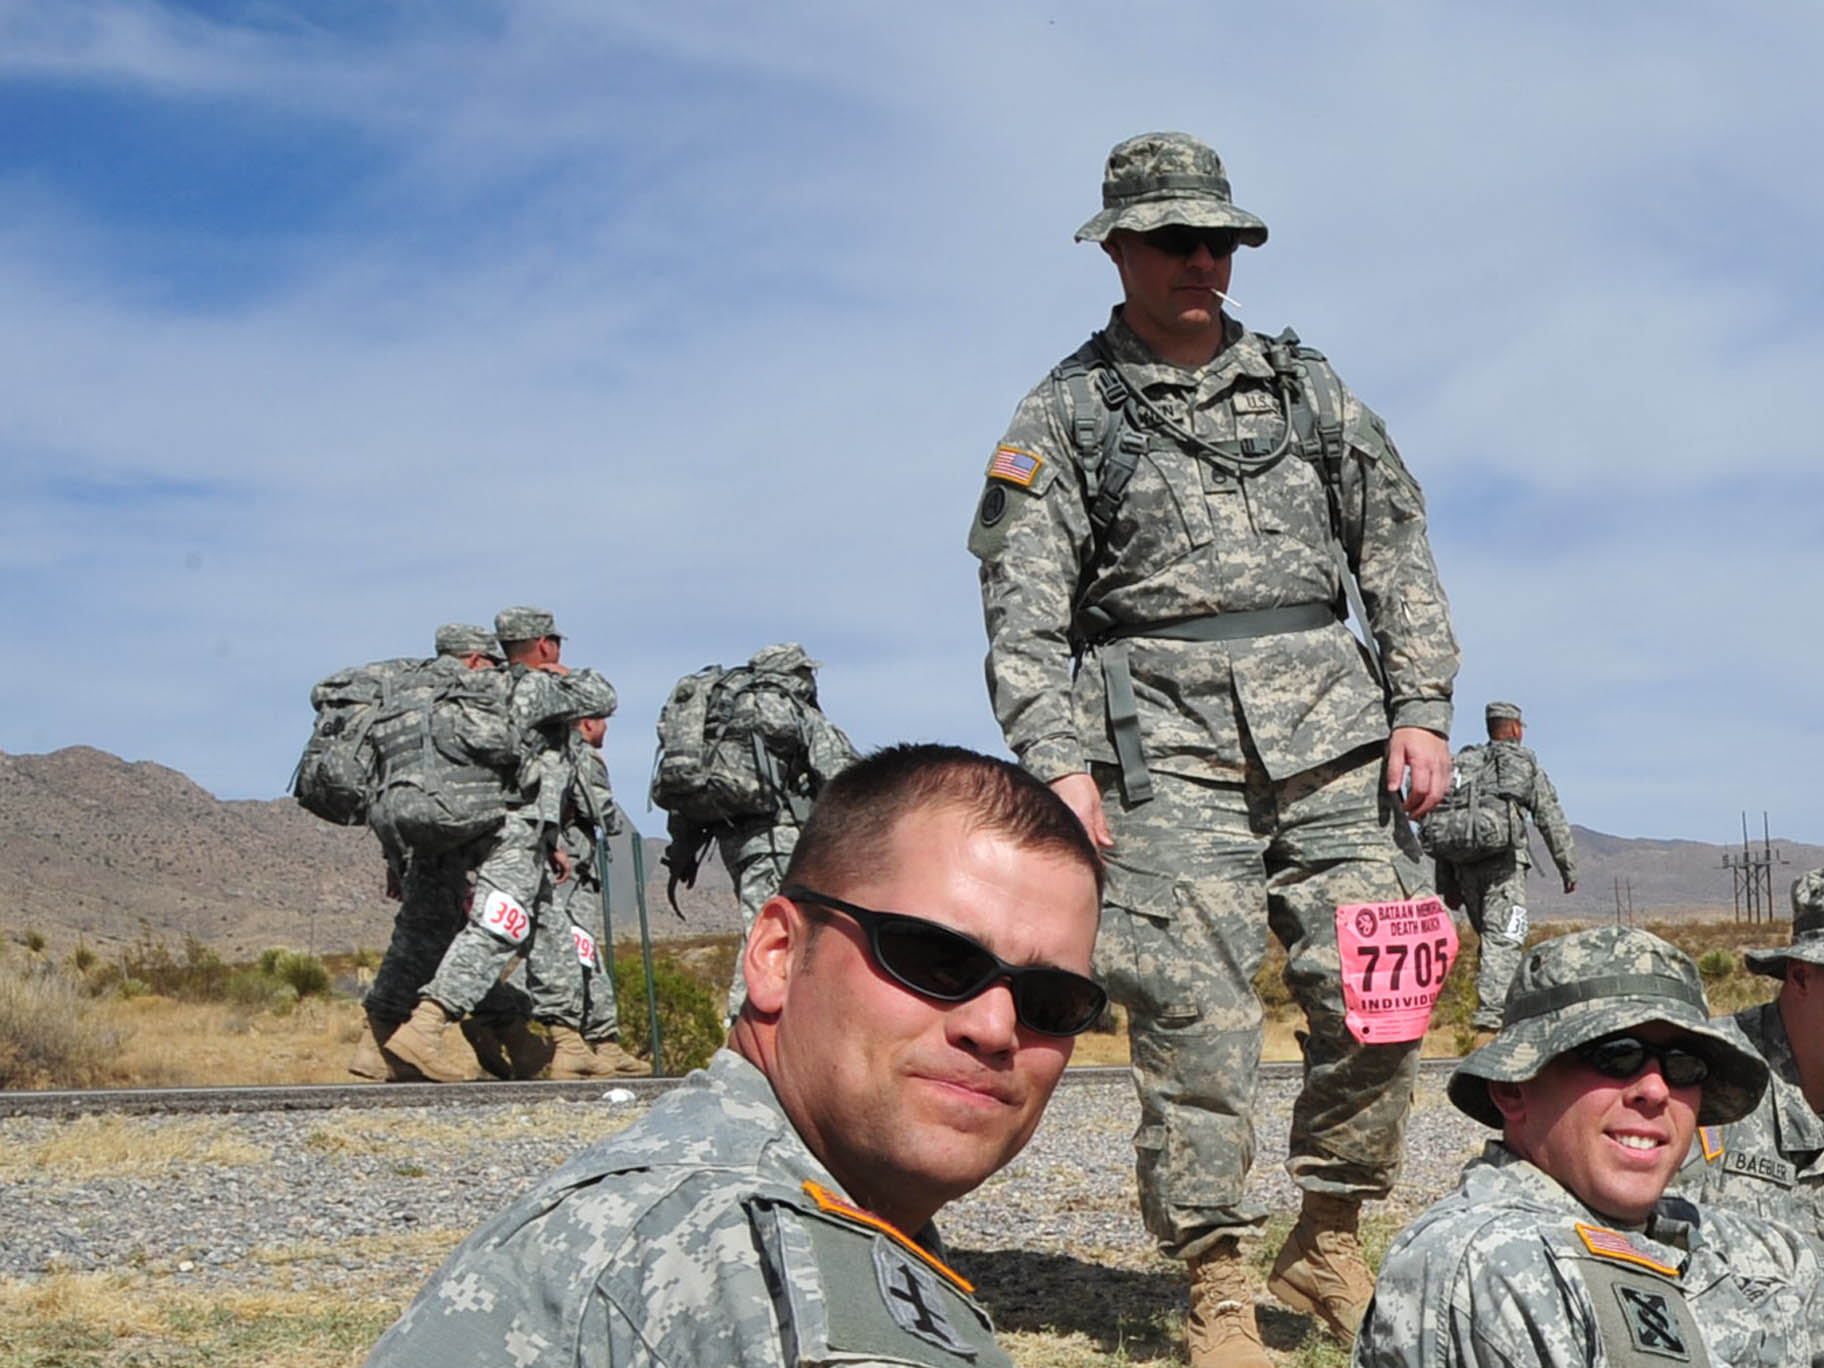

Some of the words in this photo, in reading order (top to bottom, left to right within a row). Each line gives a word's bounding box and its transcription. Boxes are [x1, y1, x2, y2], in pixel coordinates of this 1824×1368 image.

[490, 901, 528, 939] 392
[1378, 904, 1414, 921] BATAAN
[1390, 920, 1419, 937] DEATH
[1357, 937, 1449, 992] 7705
